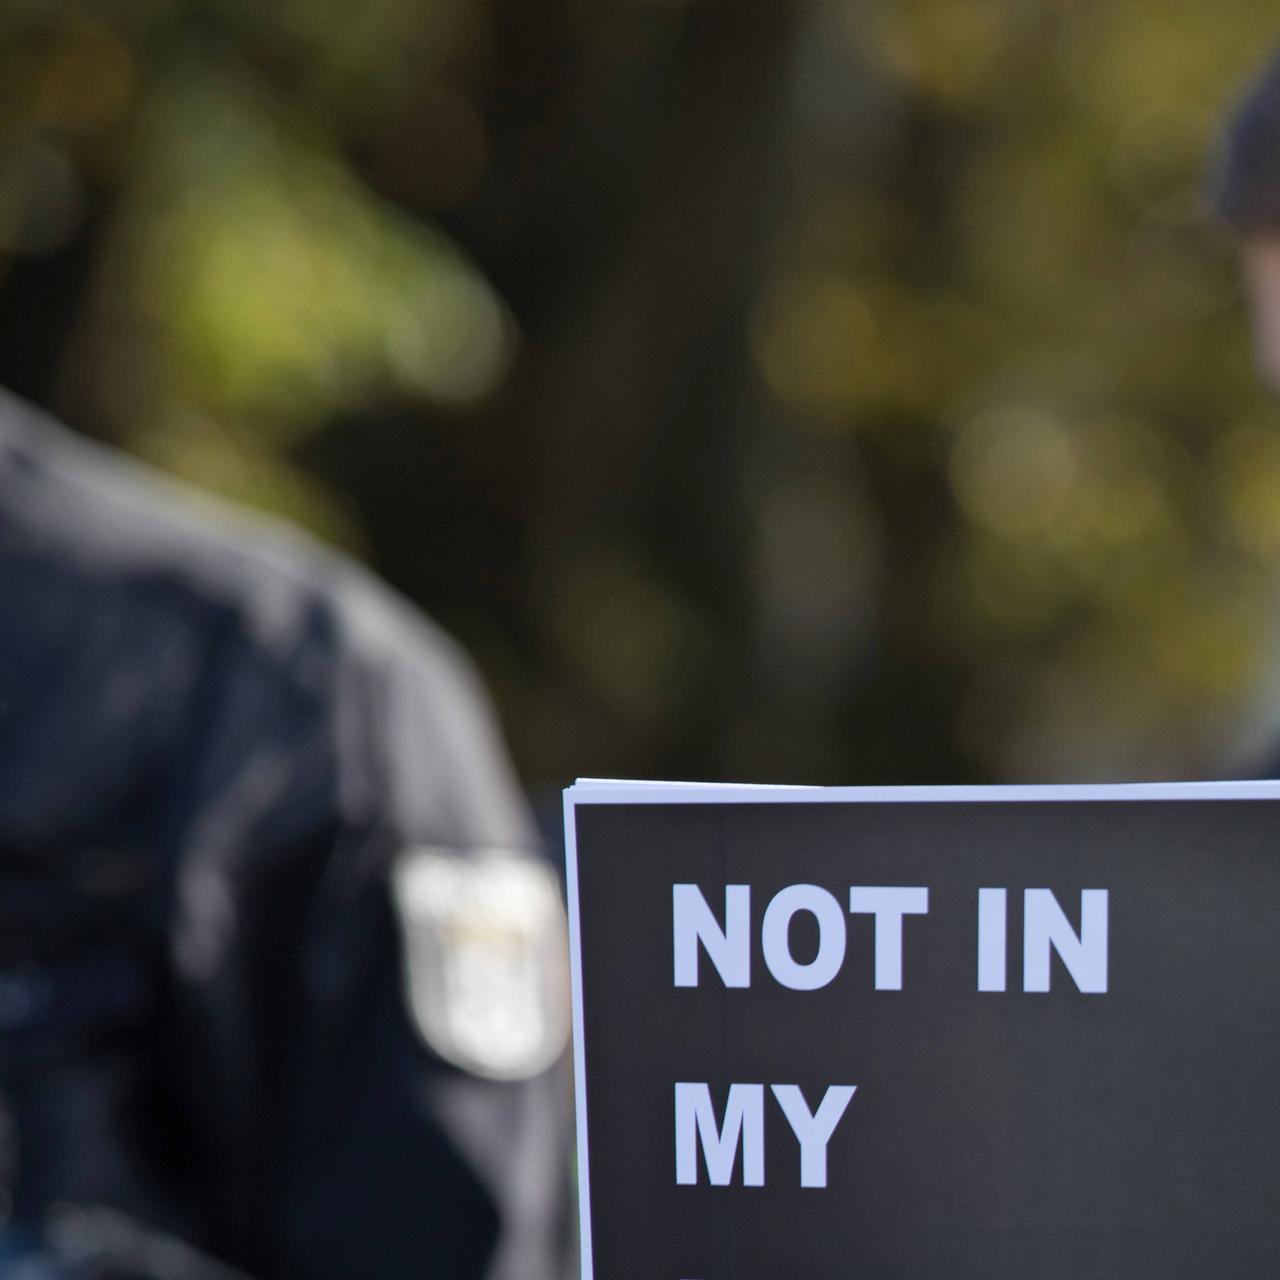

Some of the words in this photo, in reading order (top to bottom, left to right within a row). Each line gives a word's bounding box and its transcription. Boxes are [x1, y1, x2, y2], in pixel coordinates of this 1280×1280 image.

[672, 883, 929, 991] NOT
[977, 887, 1109, 994] IN
[674, 1082, 857, 1188] MY
